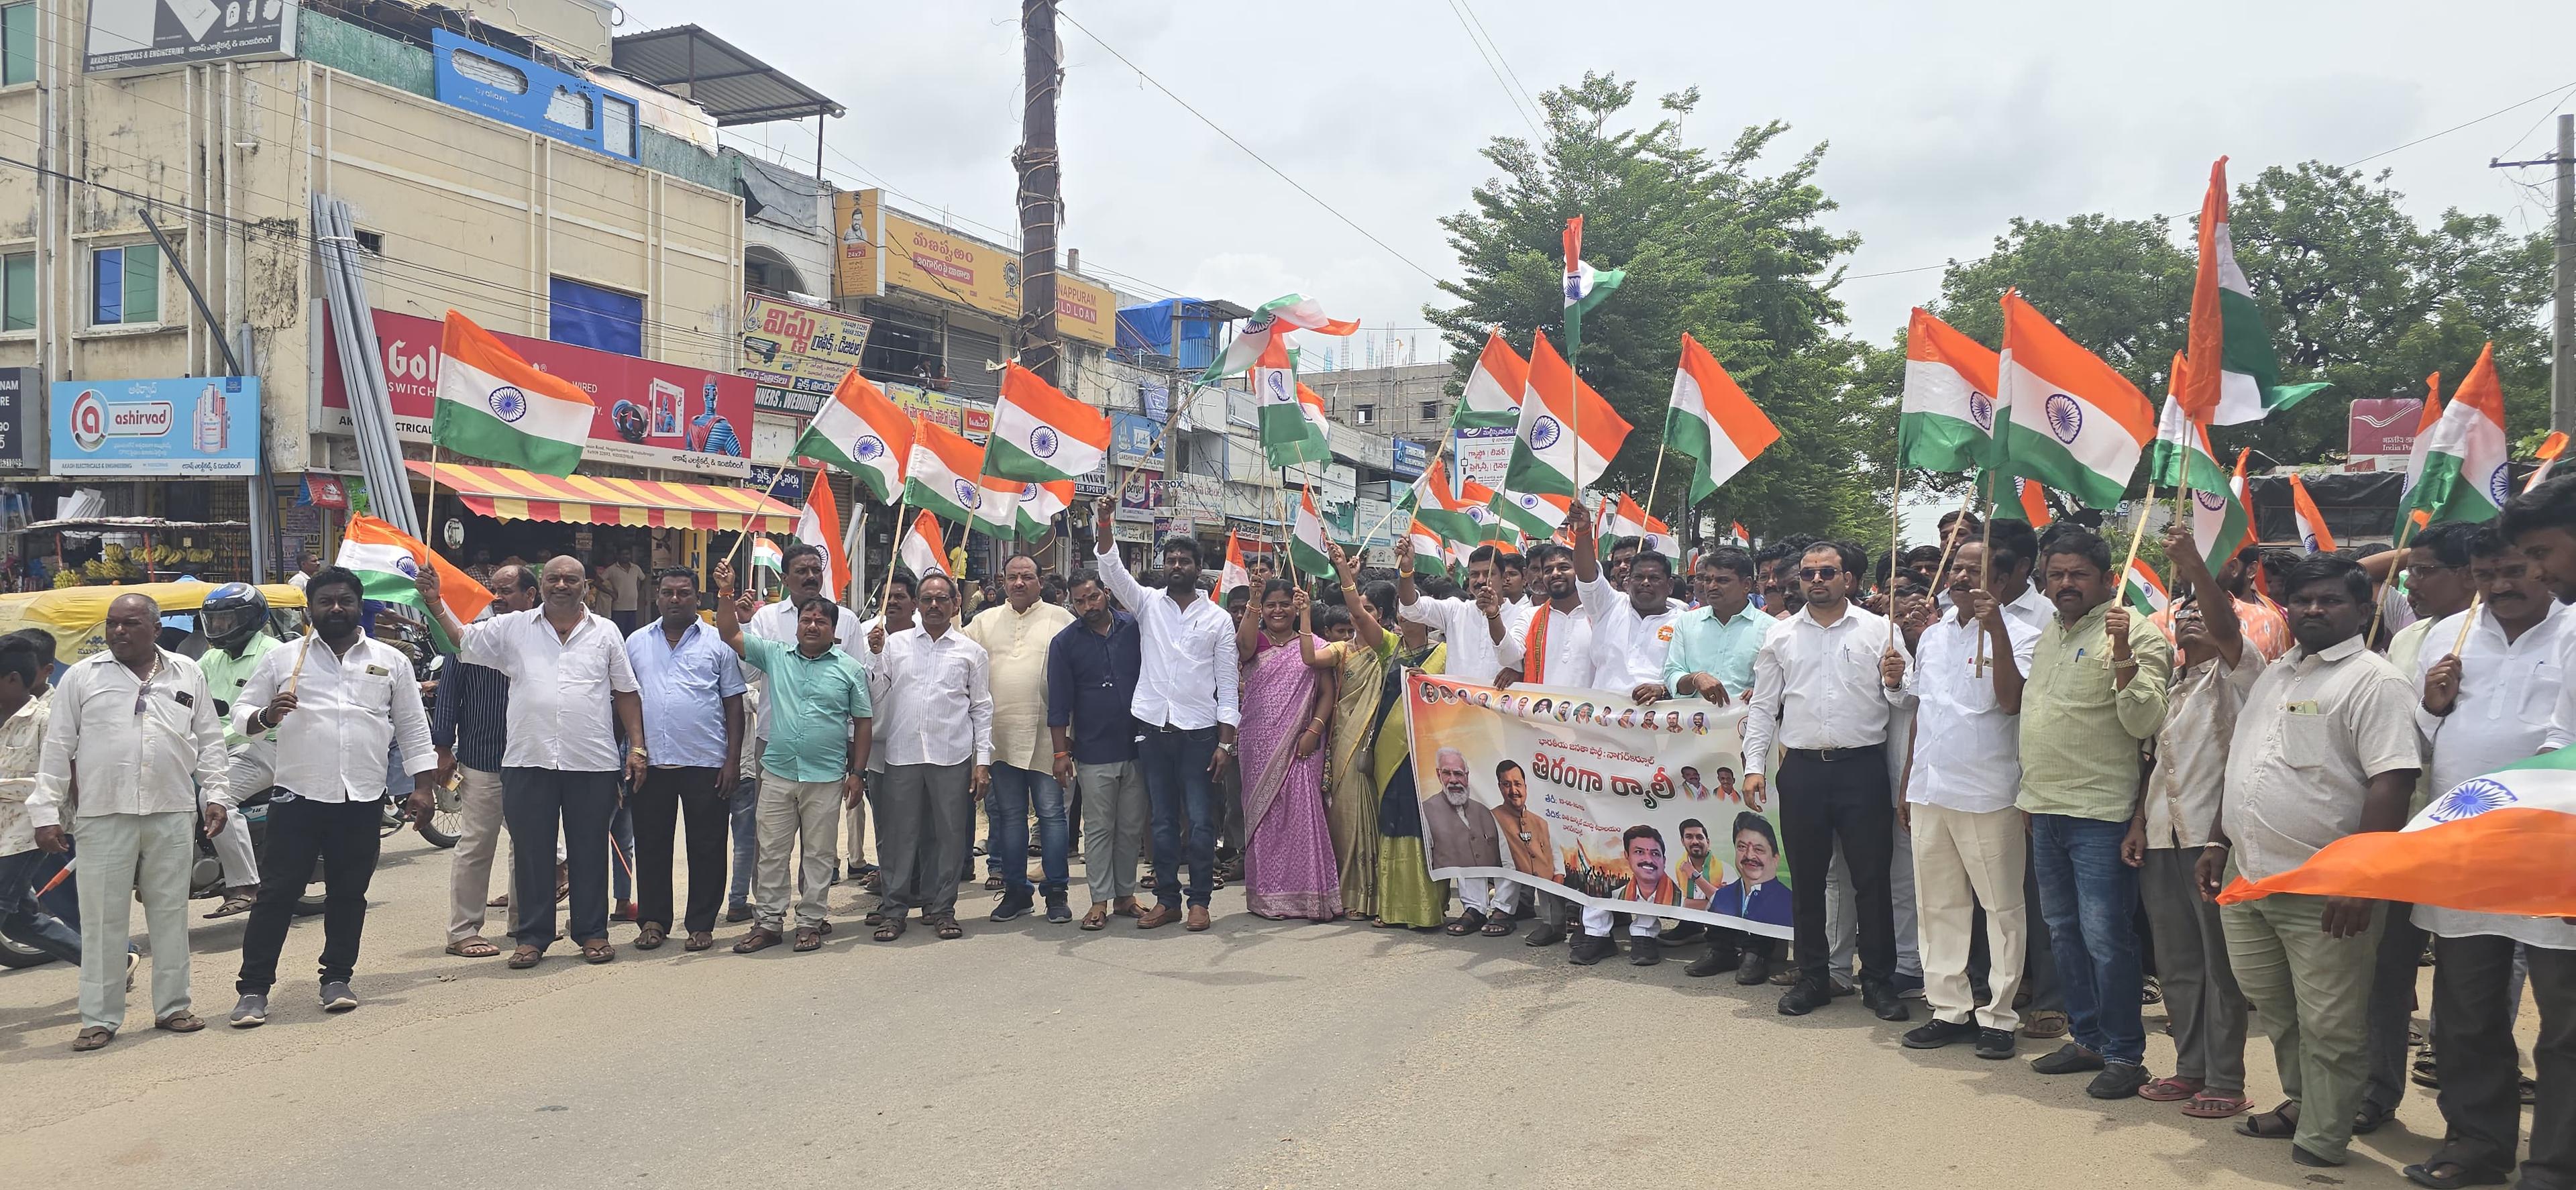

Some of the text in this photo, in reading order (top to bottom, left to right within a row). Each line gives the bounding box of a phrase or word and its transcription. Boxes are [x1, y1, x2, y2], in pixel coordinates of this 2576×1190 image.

[1058, 283, 1096, 307] NAPPURAM
[1073, 306, 1095, 322] LOAN
[0, 380, 18, 390] NAM
[388, 382, 435, 397] SWITCH
[783, 391, 819, 412] WEDDING
[115, 410, 166, 425] ashirvad
[1087, 485, 1104, 494] SPORTS
[1126, 482, 1144, 497] Berger
[1538, 739, 1568, 749] భారతీయ
[1569, 743, 1589, 753] జనతా
[1532, 752, 1676, 810] తిరంగా ర్యాలీ
